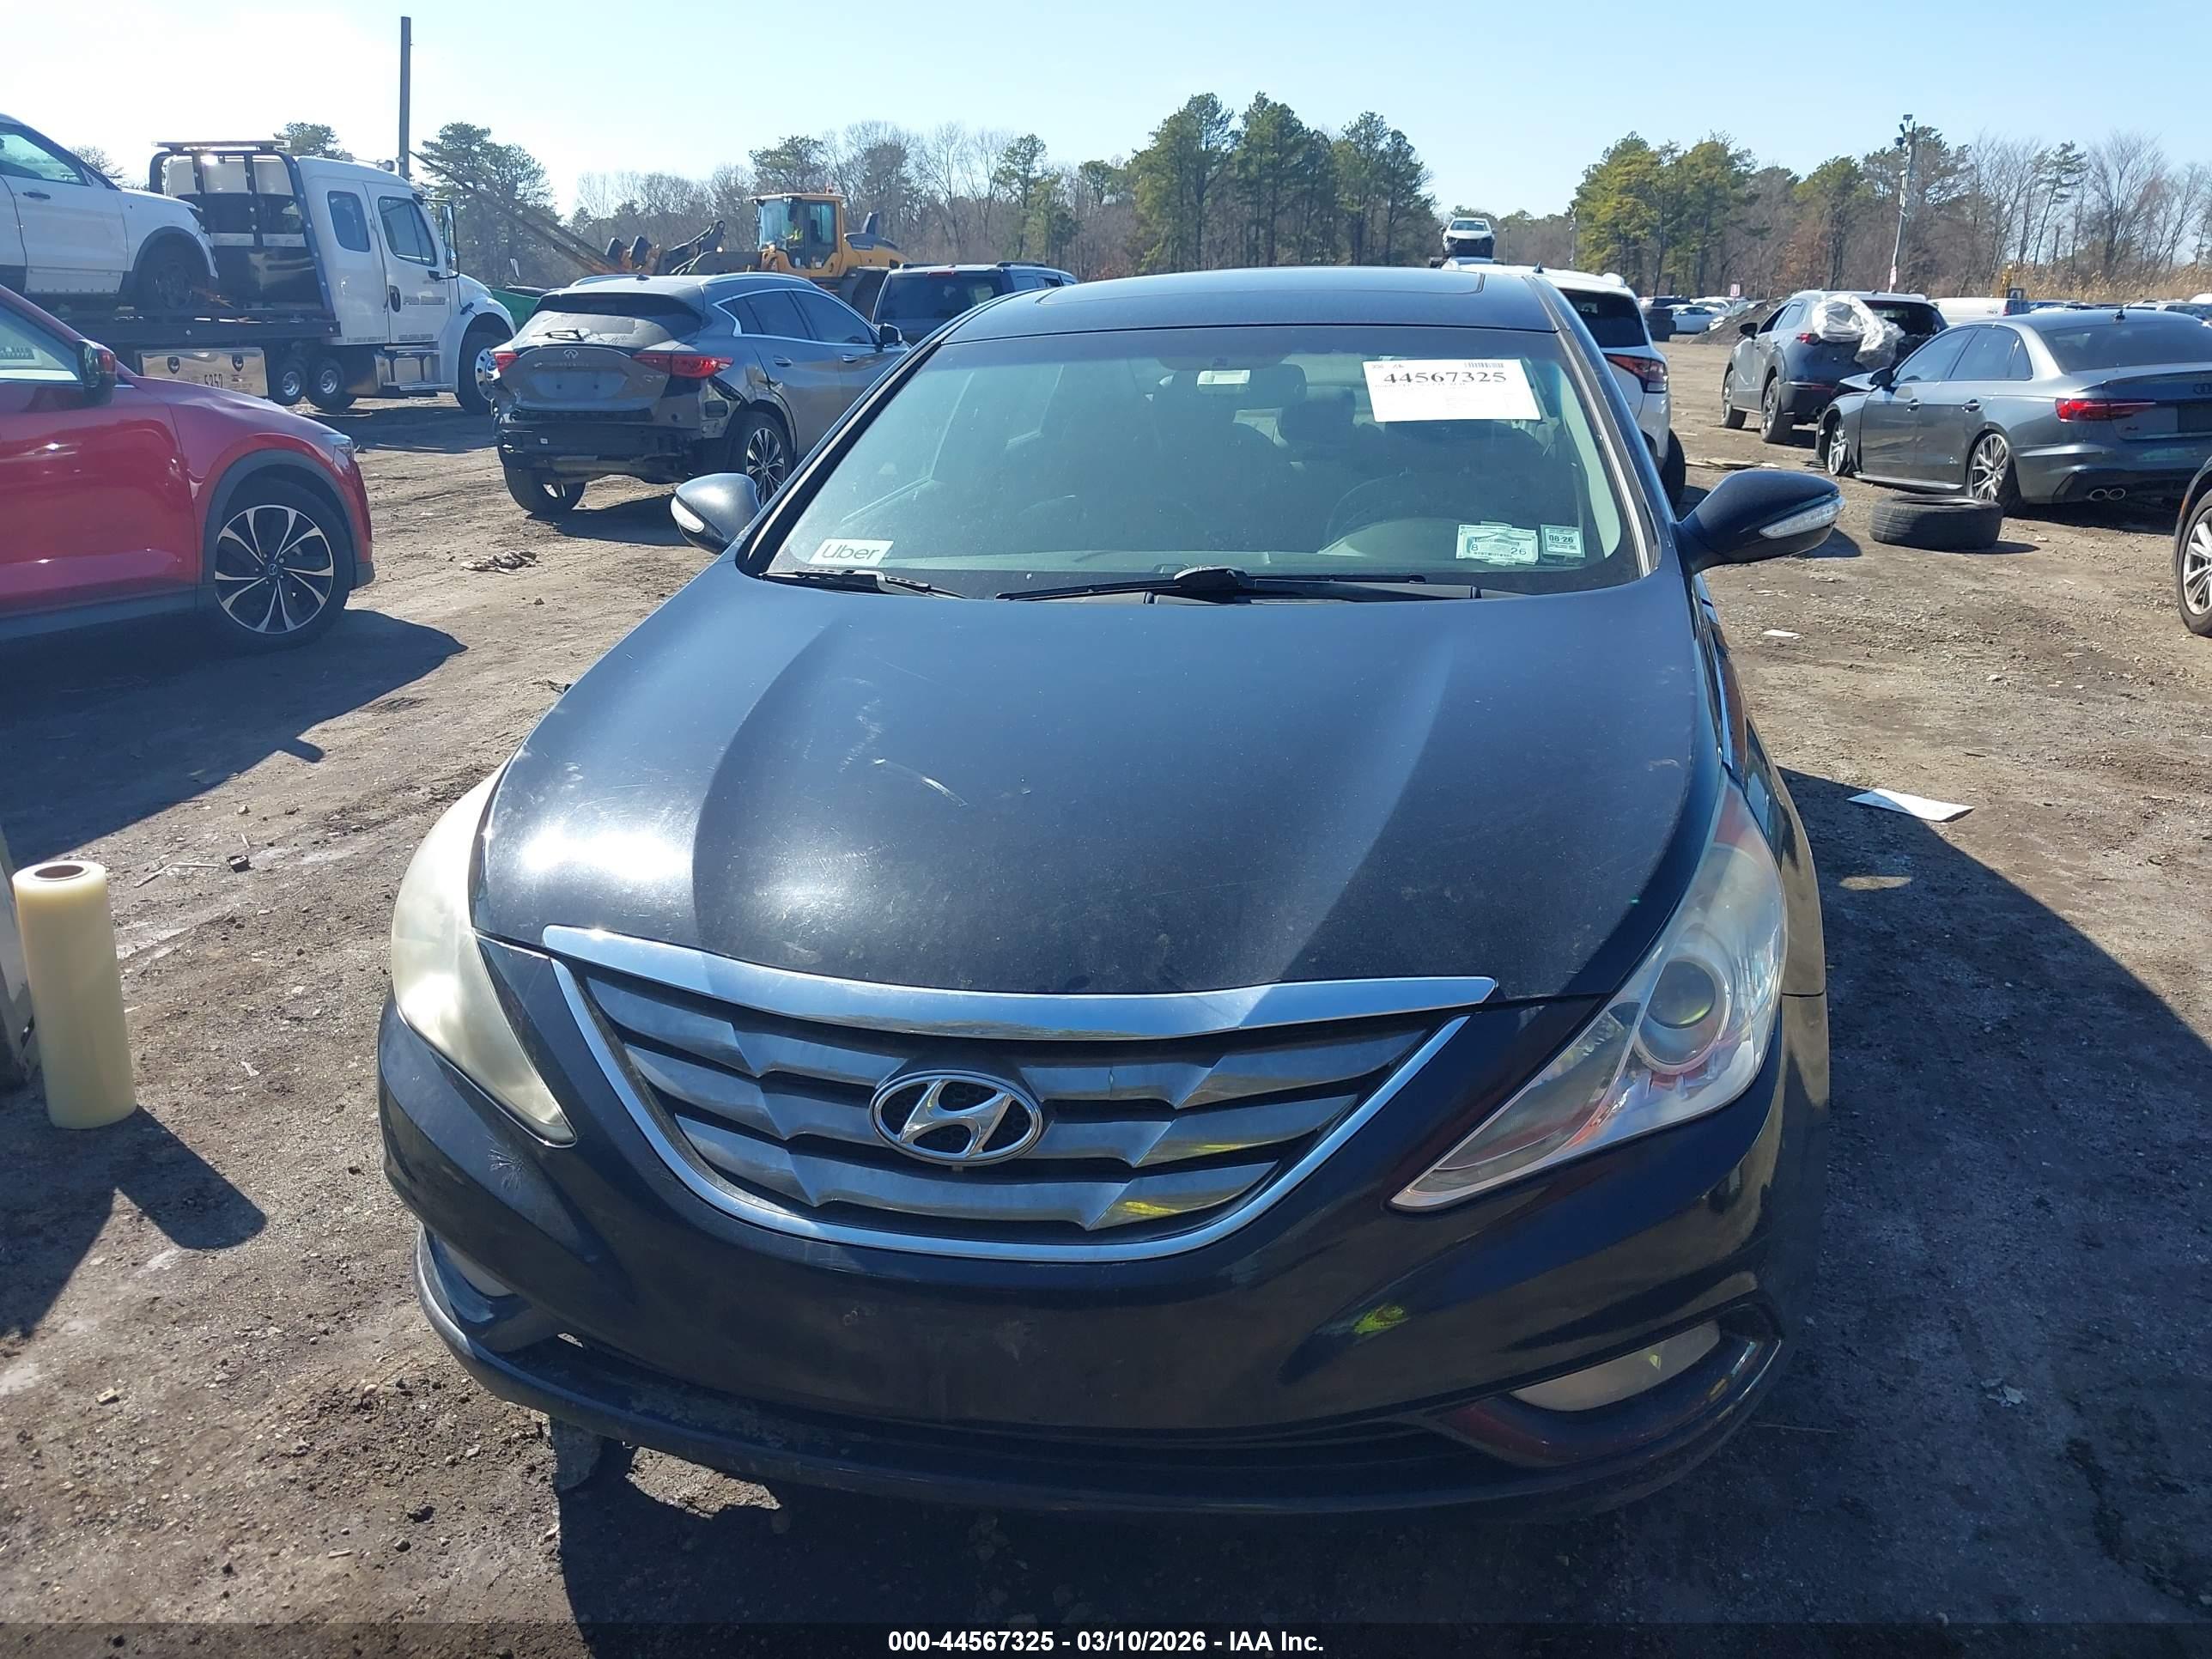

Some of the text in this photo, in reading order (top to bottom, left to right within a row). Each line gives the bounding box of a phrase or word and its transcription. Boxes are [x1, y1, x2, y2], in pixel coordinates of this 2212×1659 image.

[1383, 372, 1507, 384] 44567325
[822, 544, 880, 560] Uber
[1510, 547, 1527, 556] 26
